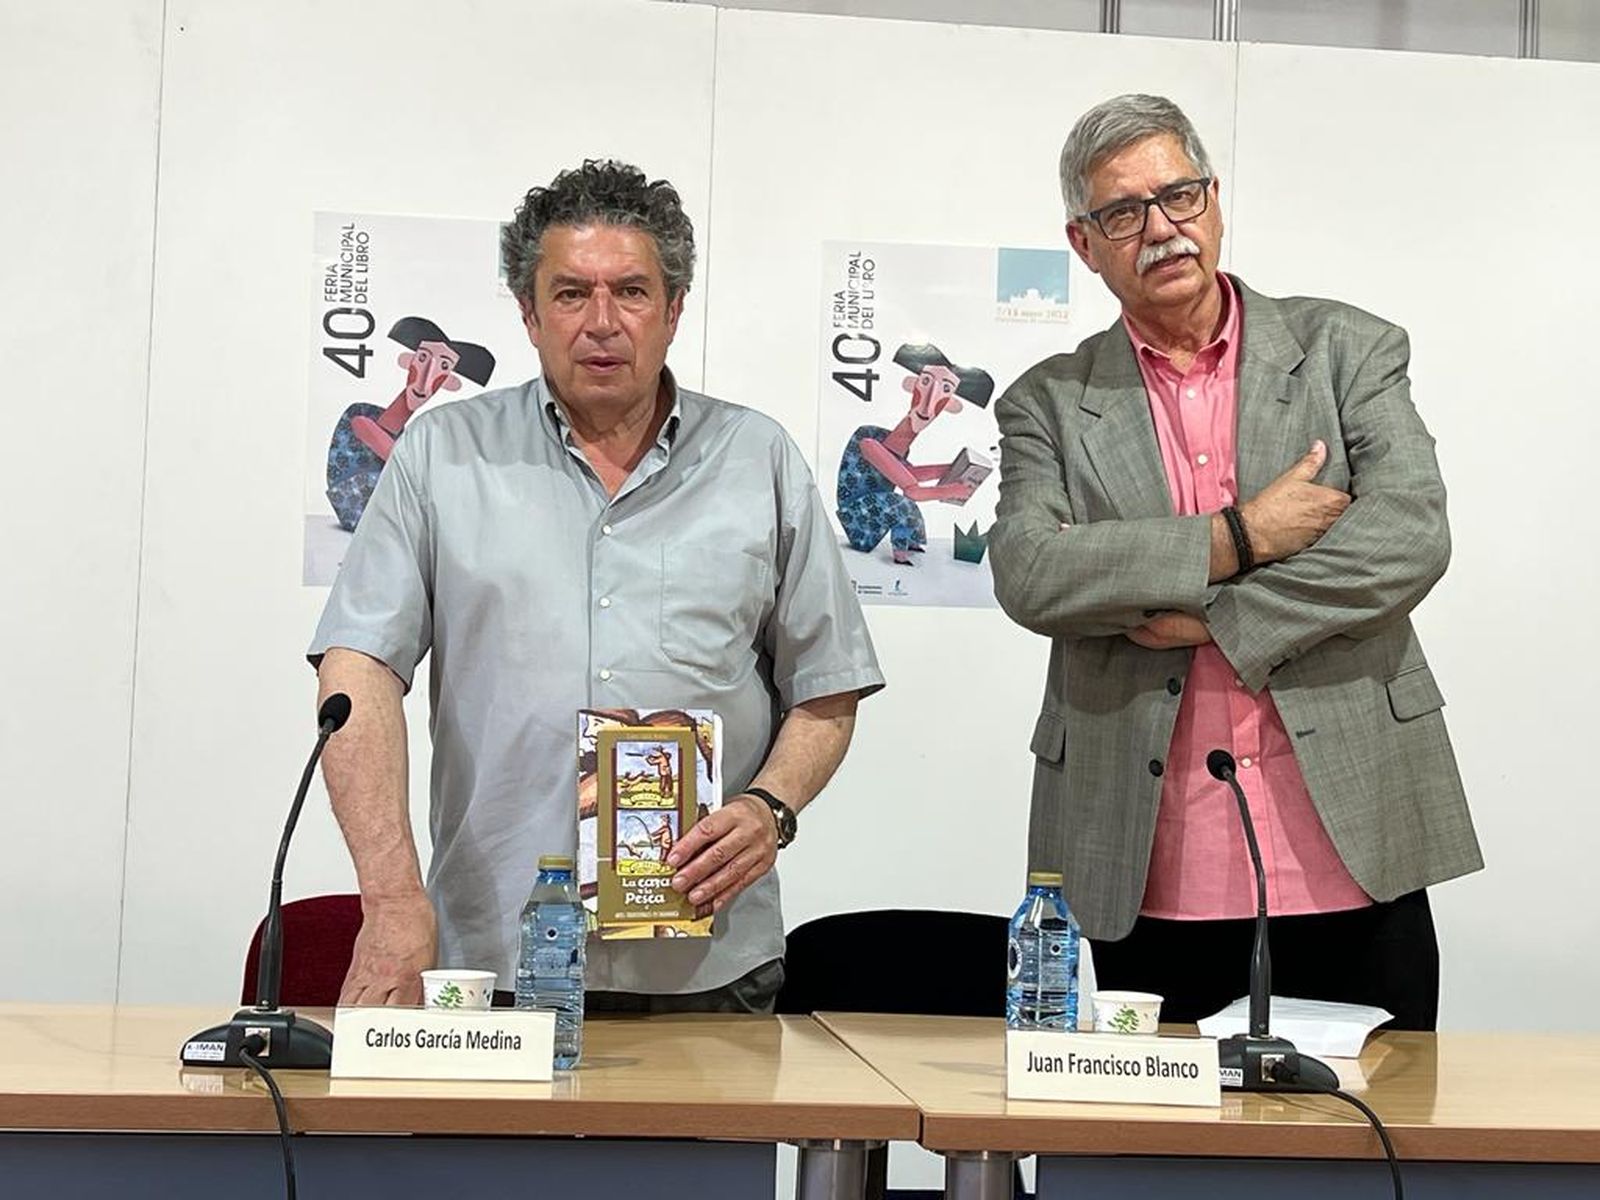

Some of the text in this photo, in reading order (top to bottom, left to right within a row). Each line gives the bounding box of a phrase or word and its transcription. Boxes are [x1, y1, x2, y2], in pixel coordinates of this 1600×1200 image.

[339, 222, 355, 303] MUNICIPAL
[354, 231, 370, 304] DEL LIBRO
[324, 263, 338, 302] FERIA
[847, 250, 862, 329] MUNICIPAL
[833, 290, 846, 328] FERIA
[323, 307, 376, 378] 40
[832, 332, 881, 402] 40
[622, 877, 636, 887] La
[624, 891, 666, 905] Pesca
[365, 1026, 522, 1050] Carlos García Medina
[1027, 1051, 1200, 1079] Juan Francisco Blanco
